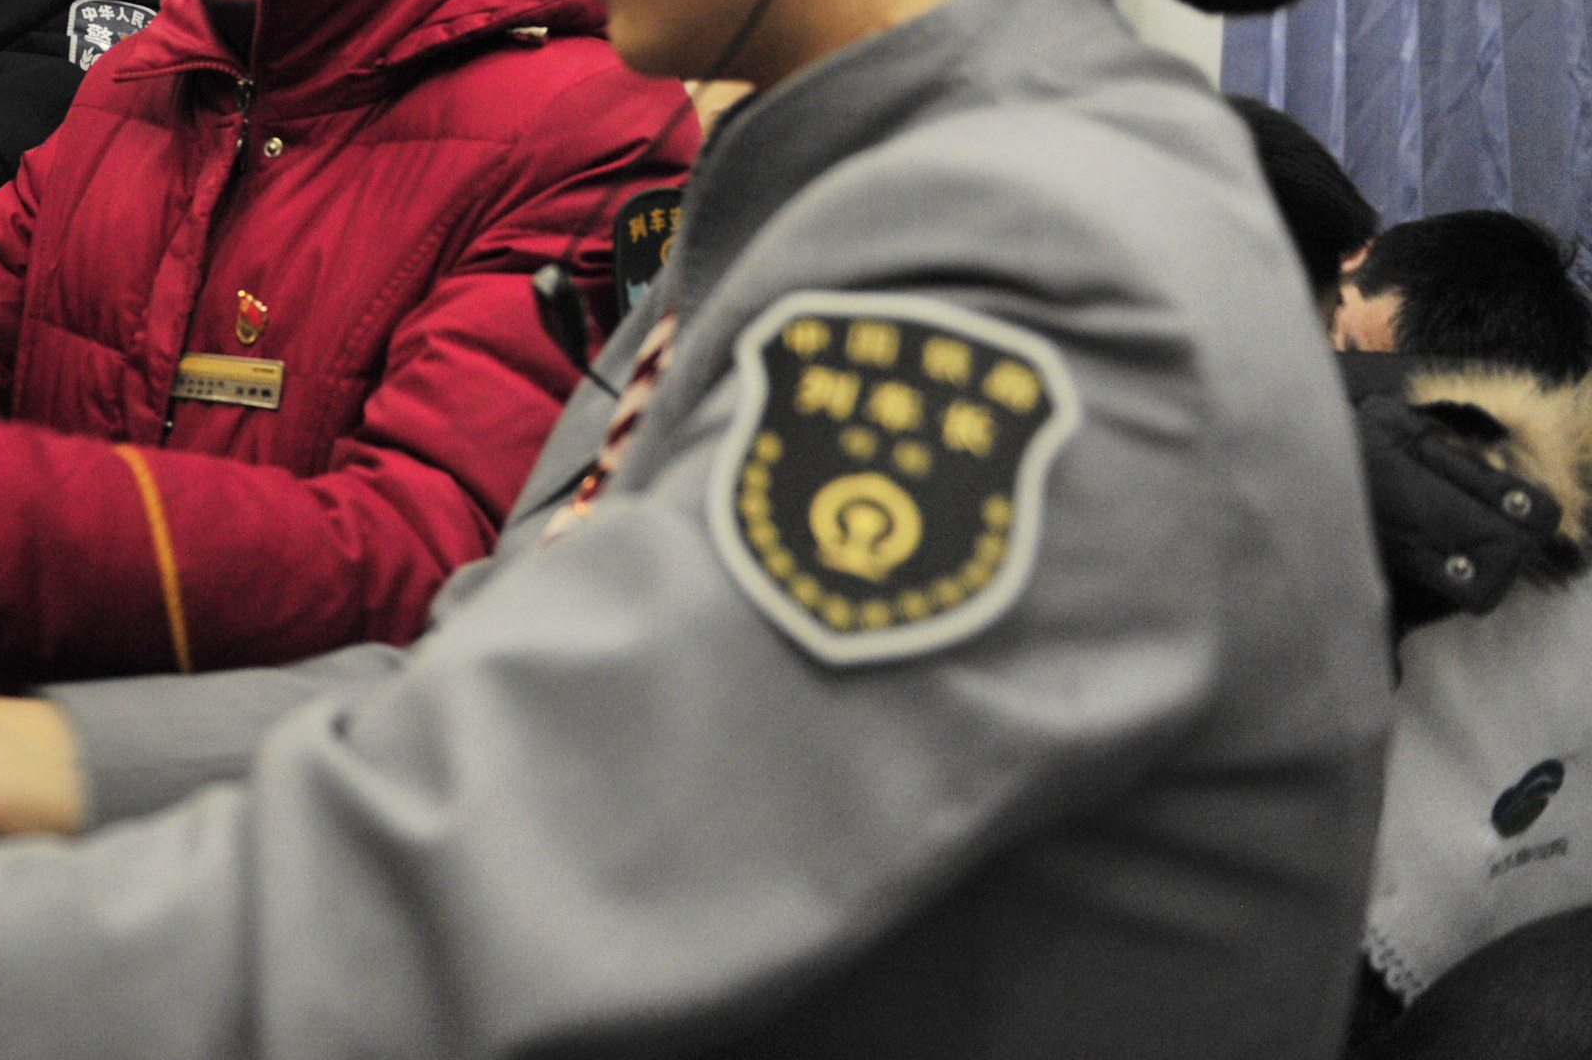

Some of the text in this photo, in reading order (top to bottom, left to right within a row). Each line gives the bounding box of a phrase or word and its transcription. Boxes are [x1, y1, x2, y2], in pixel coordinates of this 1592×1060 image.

[81, 5, 153, 29] 中华人民
[84, 23, 114, 52] 警
